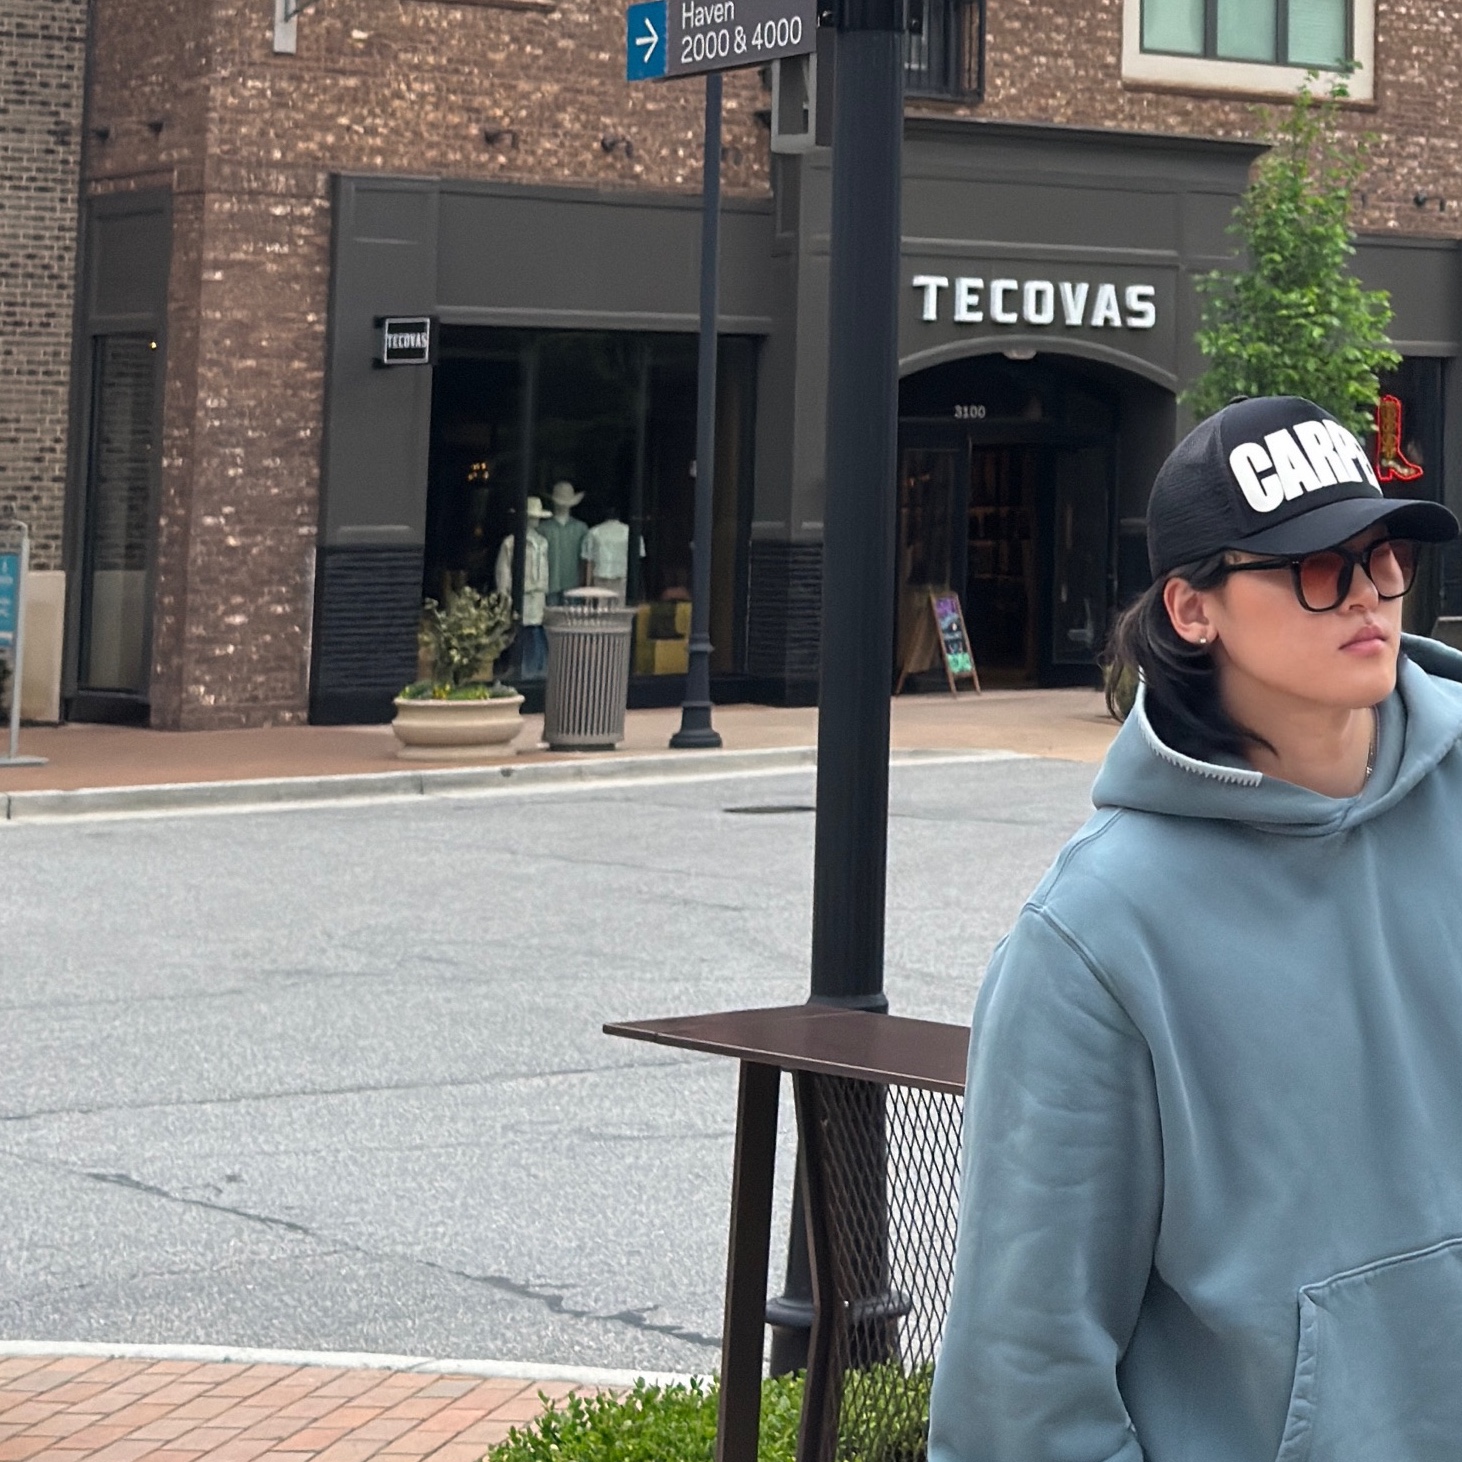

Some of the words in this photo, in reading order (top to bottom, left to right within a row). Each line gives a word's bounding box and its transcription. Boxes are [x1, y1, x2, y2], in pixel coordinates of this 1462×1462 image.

[682, 0, 735, 30] Haven
[680, 28, 730, 64] 2000
[733, 25, 748, 54] &
[751, 15, 802, 51] 4000
[912, 274, 1157, 329] TECOVAS
[953, 404, 986, 419] 3100
